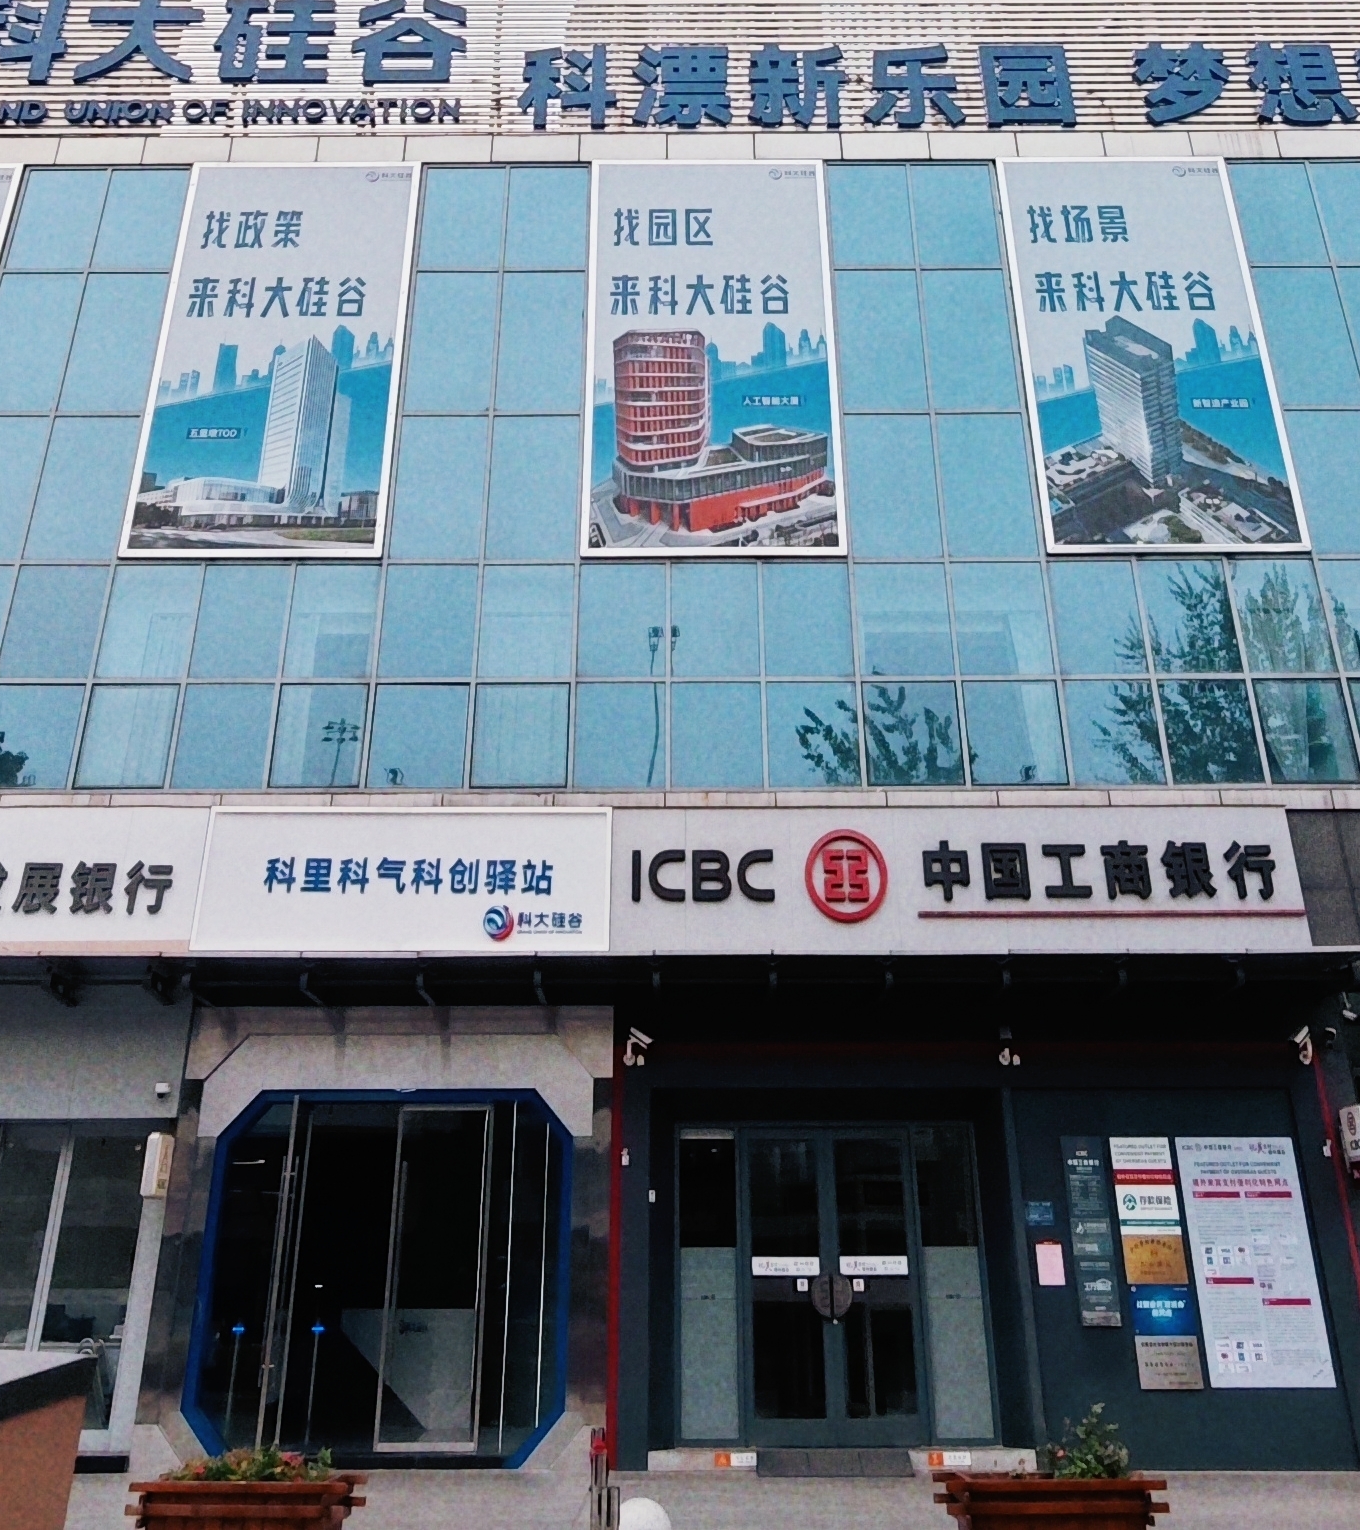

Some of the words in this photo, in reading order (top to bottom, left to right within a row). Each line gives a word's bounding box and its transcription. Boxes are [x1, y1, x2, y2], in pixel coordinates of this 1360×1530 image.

[518, 43, 1077, 130] 科漂新乐园
[63, 98, 176, 126] UNION
[183, 98, 229, 126] OF
[241, 96, 462, 126] INNOVATION
[200, 209, 304, 251] 找政策
[613, 207, 715, 248] 找园区
[1026, 204, 1129, 245] 找场景
[187, 276, 367, 320] 来科大硅谷
[609, 273, 790, 318] 来科大硅谷
[1035, 271, 1217, 315] 来科大硅谷
[263, 857, 554, 896] 科里科气科创驿站
[631, 848, 774, 903] ICBC
[921, 839, 1277, 902] 中国工商银行
[517, 912, 582, 928] 科大硅谷
[1140, 1196, 1171, 1205] 存款保险
